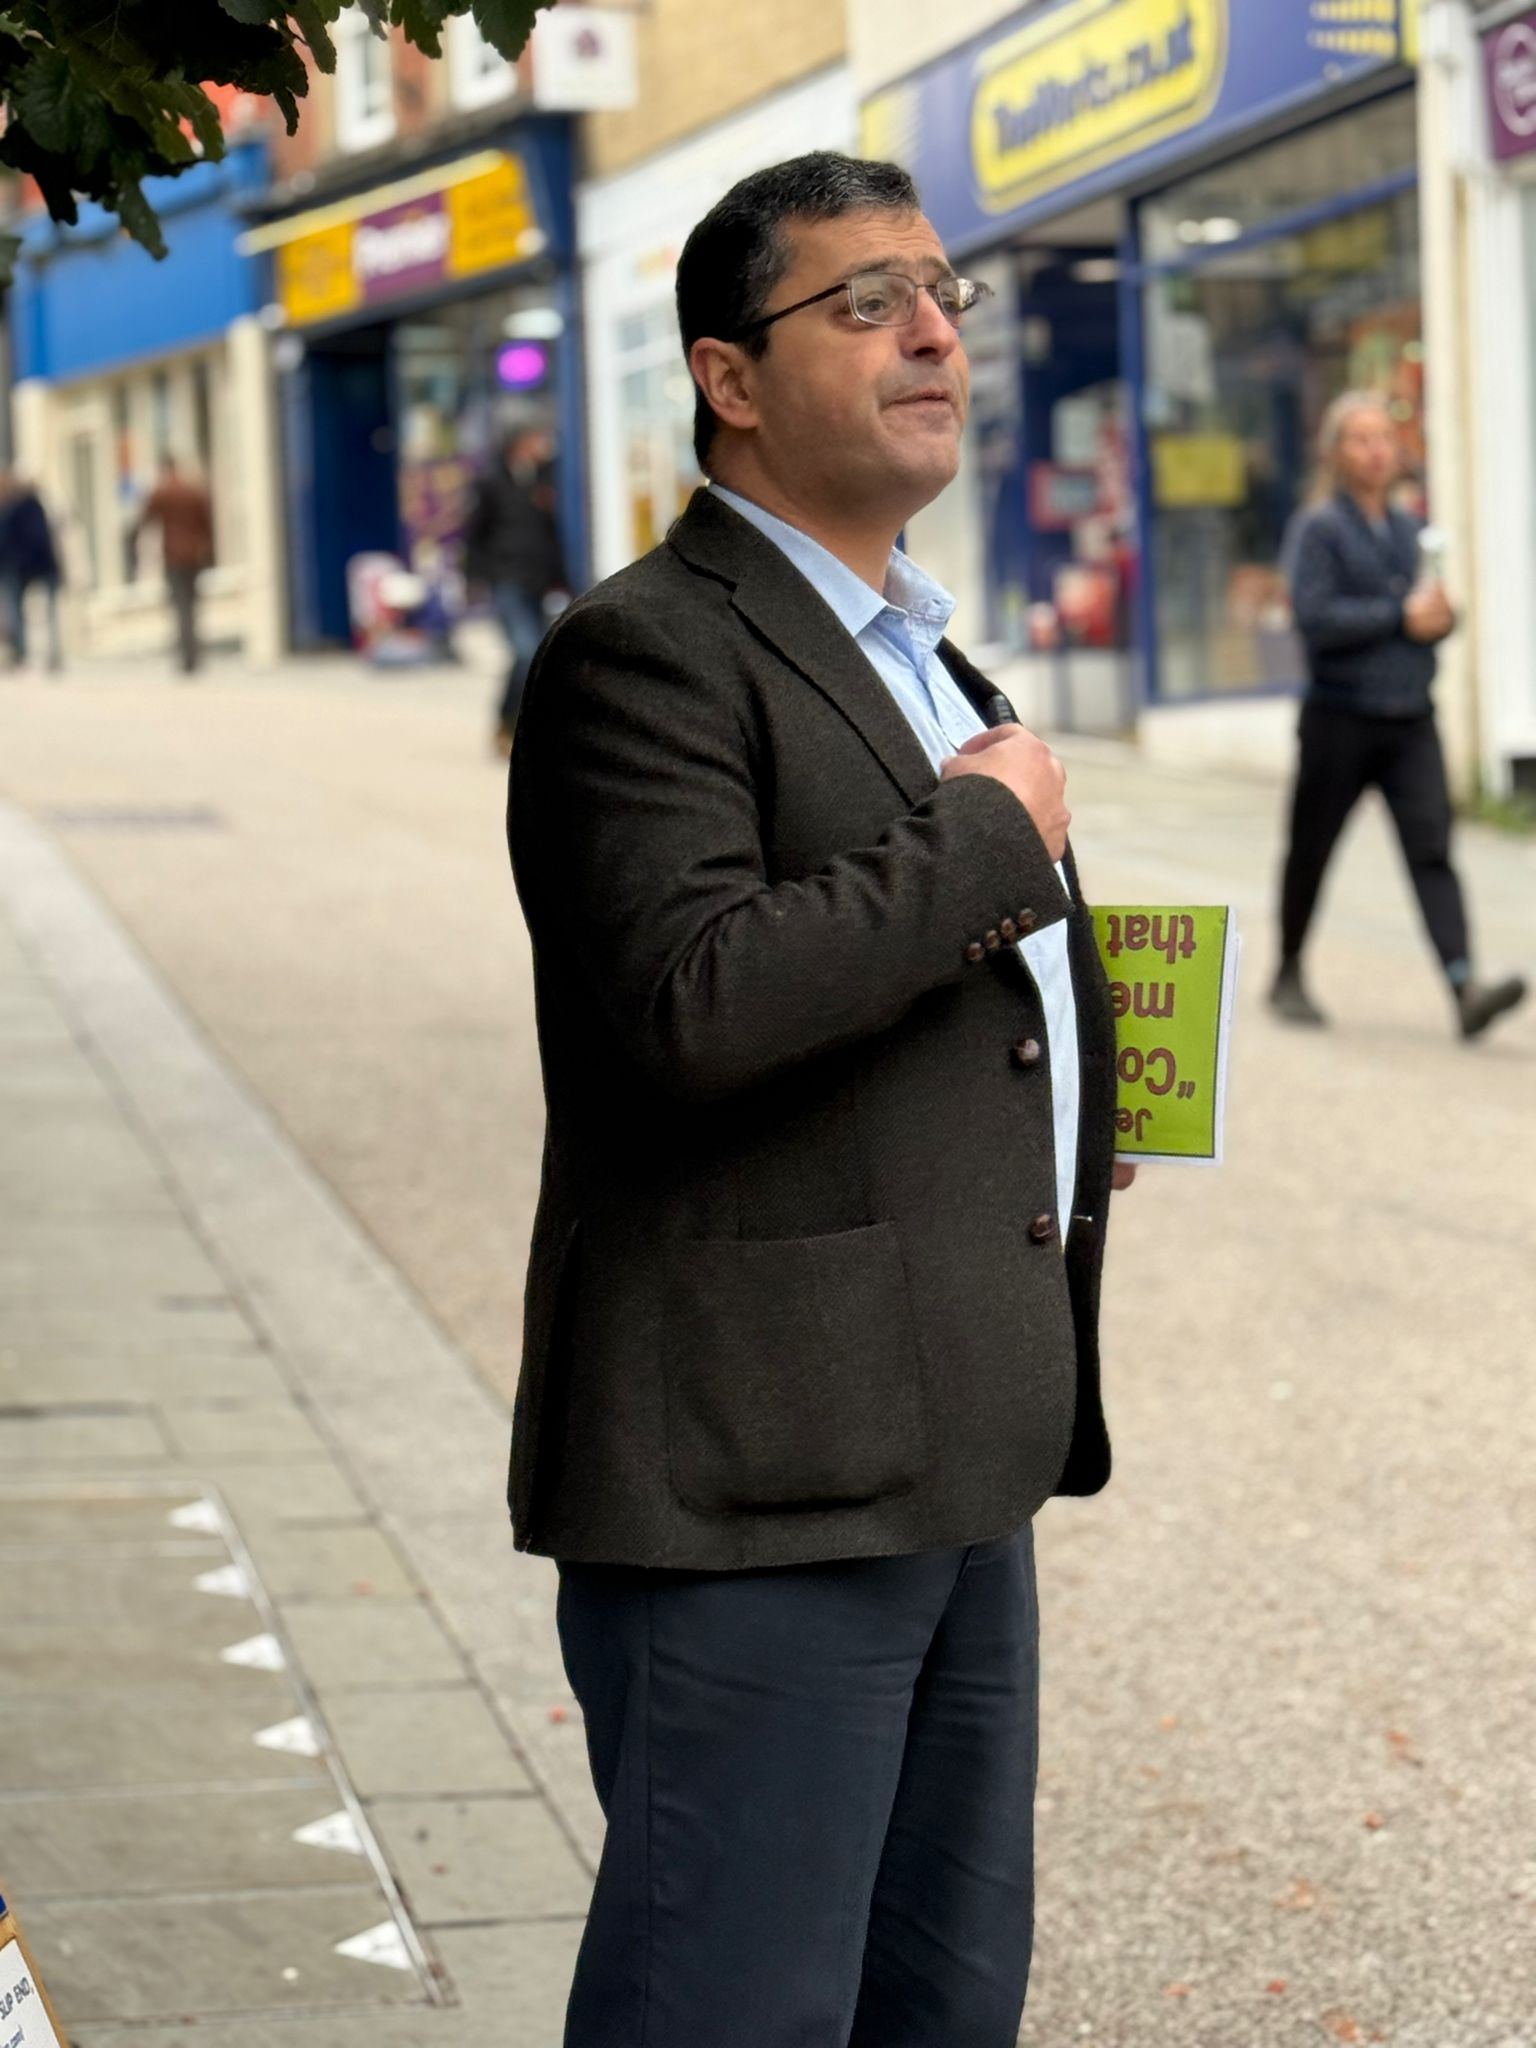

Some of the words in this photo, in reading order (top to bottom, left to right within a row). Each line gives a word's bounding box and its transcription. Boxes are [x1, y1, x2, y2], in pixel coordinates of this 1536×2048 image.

[1106, 915, 1196, 964] that
[1117, 1047, 1195, 1100] "Co
[1114, 1108, 1153, 1142] Je
